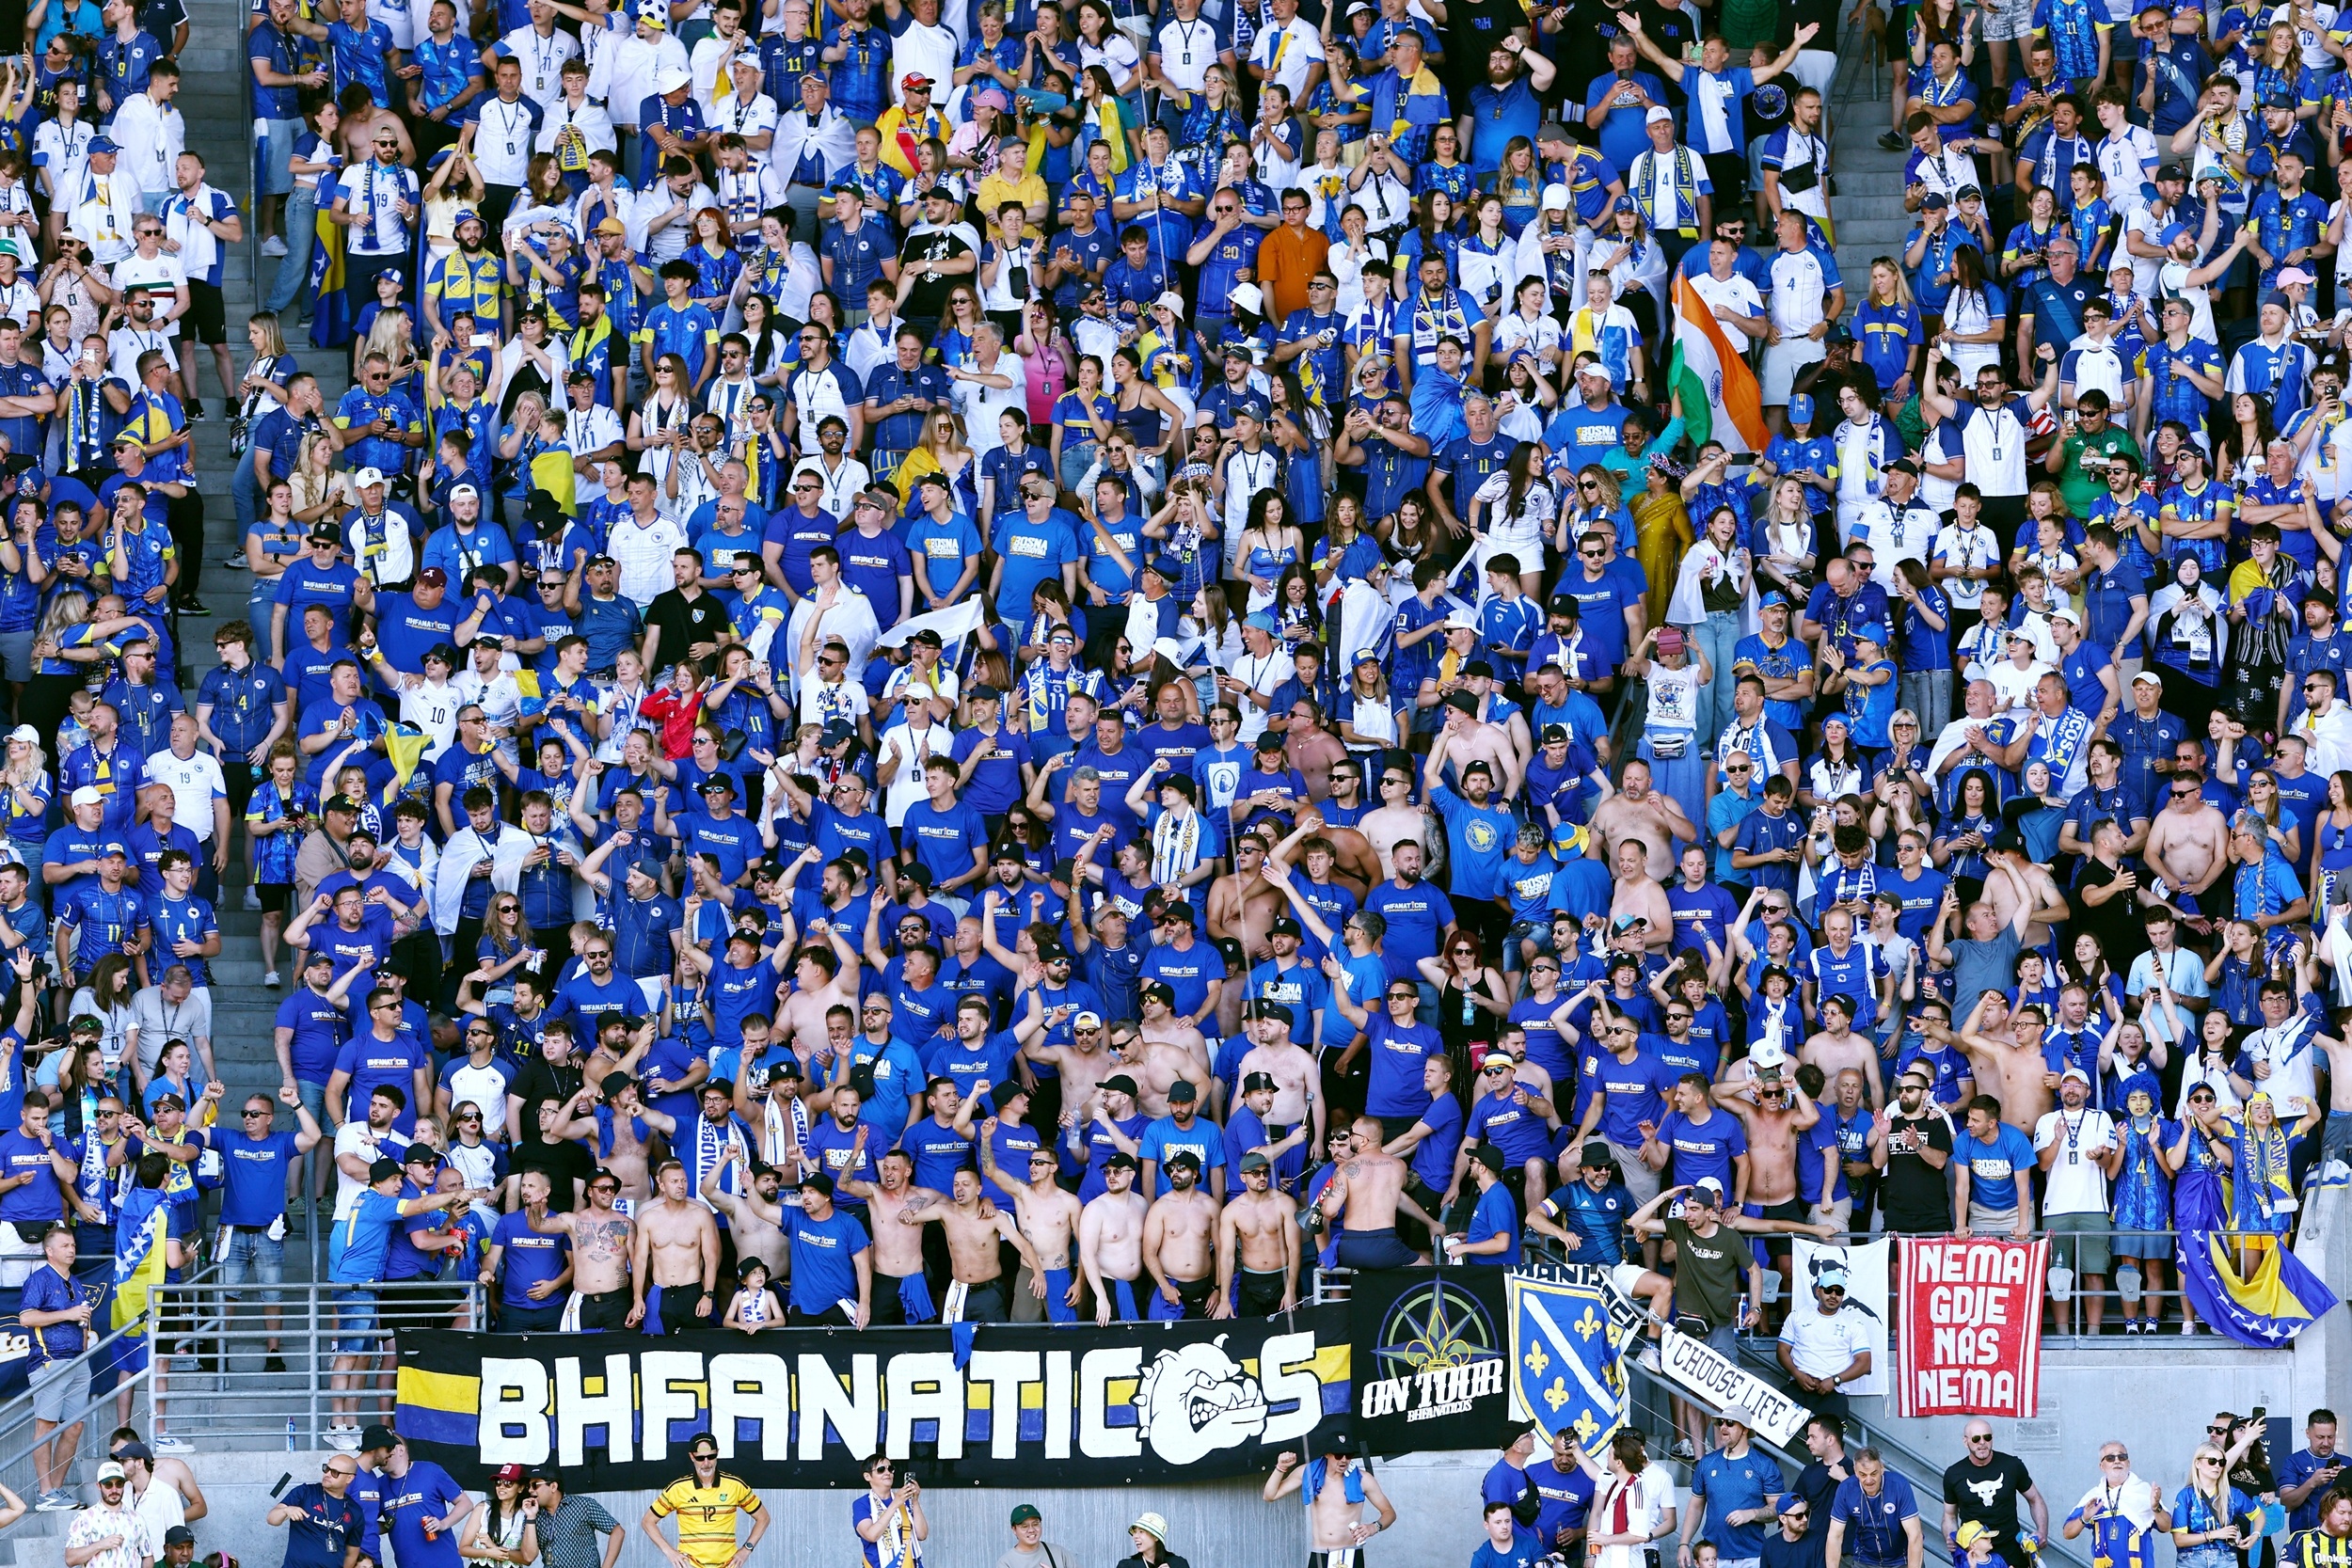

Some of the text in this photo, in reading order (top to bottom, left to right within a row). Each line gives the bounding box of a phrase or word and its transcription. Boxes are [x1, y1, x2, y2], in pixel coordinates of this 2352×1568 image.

[1474, 16, 1492, 30] BiH
[2065, 21, 2078, 35] 11
[2301, 30, 2314, 45] 19
[787, 56, 803, 72] 11
[857, 51, 869, 64] 11
[118, 62, 126, 77] 9
[2112, 160, 2123, 177] 11
[1661, 172, 1670, 186] 4
[1447, 180, 1459, 194] 19
[374, 193, 389, 207] 19
[1223, 245, 1239, 260] 20
[611, 278, 623, 292] 19
[1787, 277, 1796, 291] 4
[958, 352, 974, 366] 11
[378, 407, 391, 421] 19
[1080, 428, 1089, 438] 11
[1581, 425, 1617, 436] BOSNA
[1478, 458, 1489, 473] 11
[931, 537, 960, 548] BOSNA
[1015, 535, 1048, 549] BOSNA
[238, 695, 248, 710] 4
[1049, 692, 1065, 710] 11
[430, 706, 446, 724] 10
[750, 716, 763, 732] 11
[179, 771, 191, 784] 19
[1096, 769, 1129, 778] ANATICOS
[2277, 788, 2310, 800] ANATICOS
[698, 829, 739, 844] BHFANATICOS
[918, 826, 960, 837] BHFANATICOS
[1383, 902, 1428, 911] BHFANATICOS
[1901, 897, 1933, 907] ANATICOS
[107, 925, 120, 942] 11
[177, 923, 186, 939] 4
[1159, 965, 1199, 974] BHFANATICOS
[1831, 963, 1851, 972] LEGEA
[580, 1003, 624, 1012] BHFANATICOS
[514, 1039, 530, 1056] 11
[367, 1058, 409, 1068] BHFANATICOS
[1605, 1082, 1645, 1091] BHFANATICOS
[924, 1142, 970, 1151] BHFANATICOS
[1673, 1139, 1716, 1151] BHFANATICOS
[11, 1152, 51, 1164] BHFANATICO
[829, 1148, 867, 1162] BOSA
[1975, 1159, 2012, 1171] BOSNA
[2136, 1158, 2147, 1174] 4
[512, 1236, 555, 1246] BHFANATICOS
[1919, 1243, 2024, 1285] NEMA
[1931, 1286, 2009, 1327] GDJE
[1833, 1323, 1847, 1338] H
[1933, 1327, 1998, 1366] NAS
[1361, 1357, 1504, 1418] ON TOUR
[1672, 1337, 1788, 1428] CHOOSE LIFE
[1917, 1368, 2014, 1410] NEMA
[1406, 1398, 1473, 1422] BHFANATICOS
[702, 1506, 717, 1523] 12
[2203, 1515, 2217, 1531] 11
